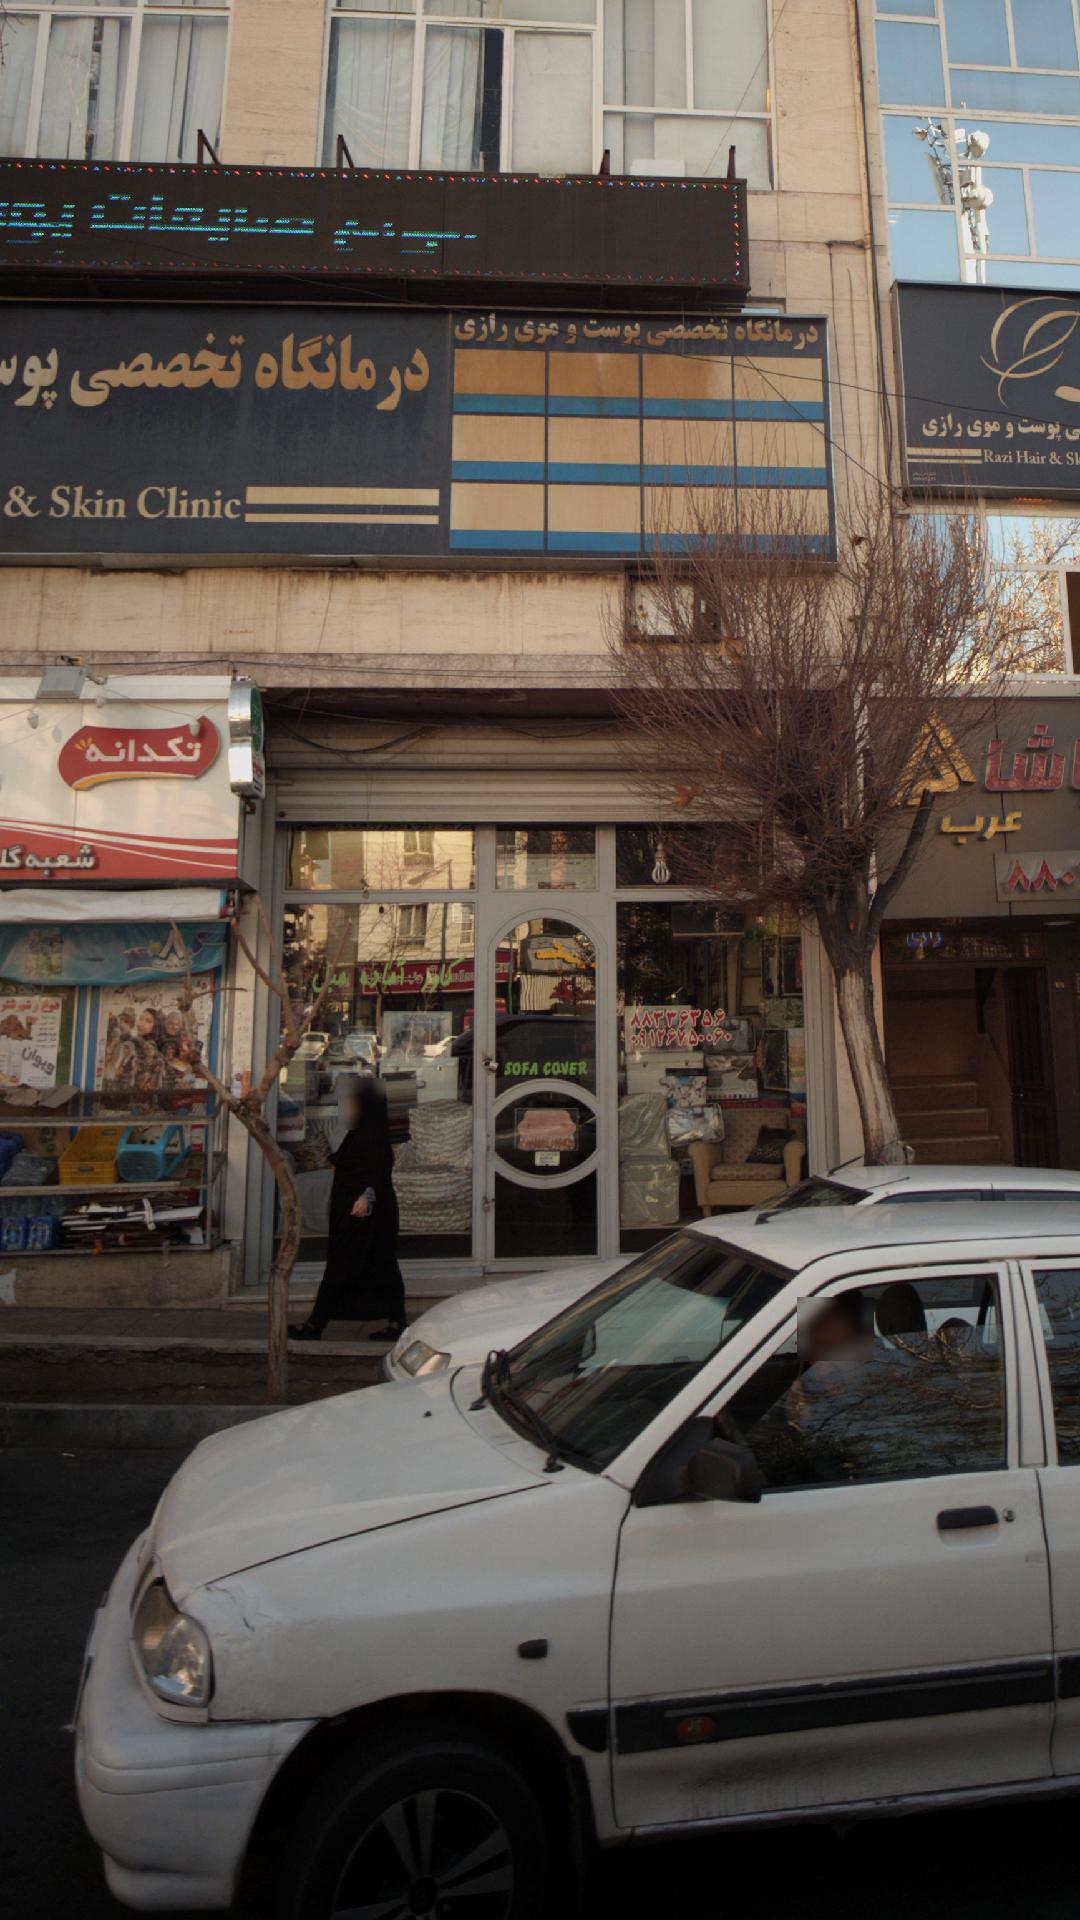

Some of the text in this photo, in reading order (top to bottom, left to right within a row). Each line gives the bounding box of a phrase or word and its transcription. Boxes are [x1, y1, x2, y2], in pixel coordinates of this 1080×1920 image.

[455, 312, 818, 349] درمانگاه تخصصی پوست و موی رازی
[71, 333, 245, 407] تخصصی
[255, 333, 430, 411] درمانگاه
[922, 413, 961, 438] رازی
[967, 418, 1000, 438] موی
[1005, 421, 1015, 438] و
[1018, 417, 1061, 441] پوست
[984, 449, 1012, 463] Razi
[1016, 450, 1046, 465] Hair
[1049, 451, 1063, 465] &
[4, 484, 241, 520] & Skin Clinic
[85, 737, 201, 763] تکدانه
[941, 811, 1022, 844] عرب
[25, 842, 96, 875] شعبه
[1008, 857, 1080, 891] ۸۸۰
[503, 1059, 588, 1076] SOFA COVER
